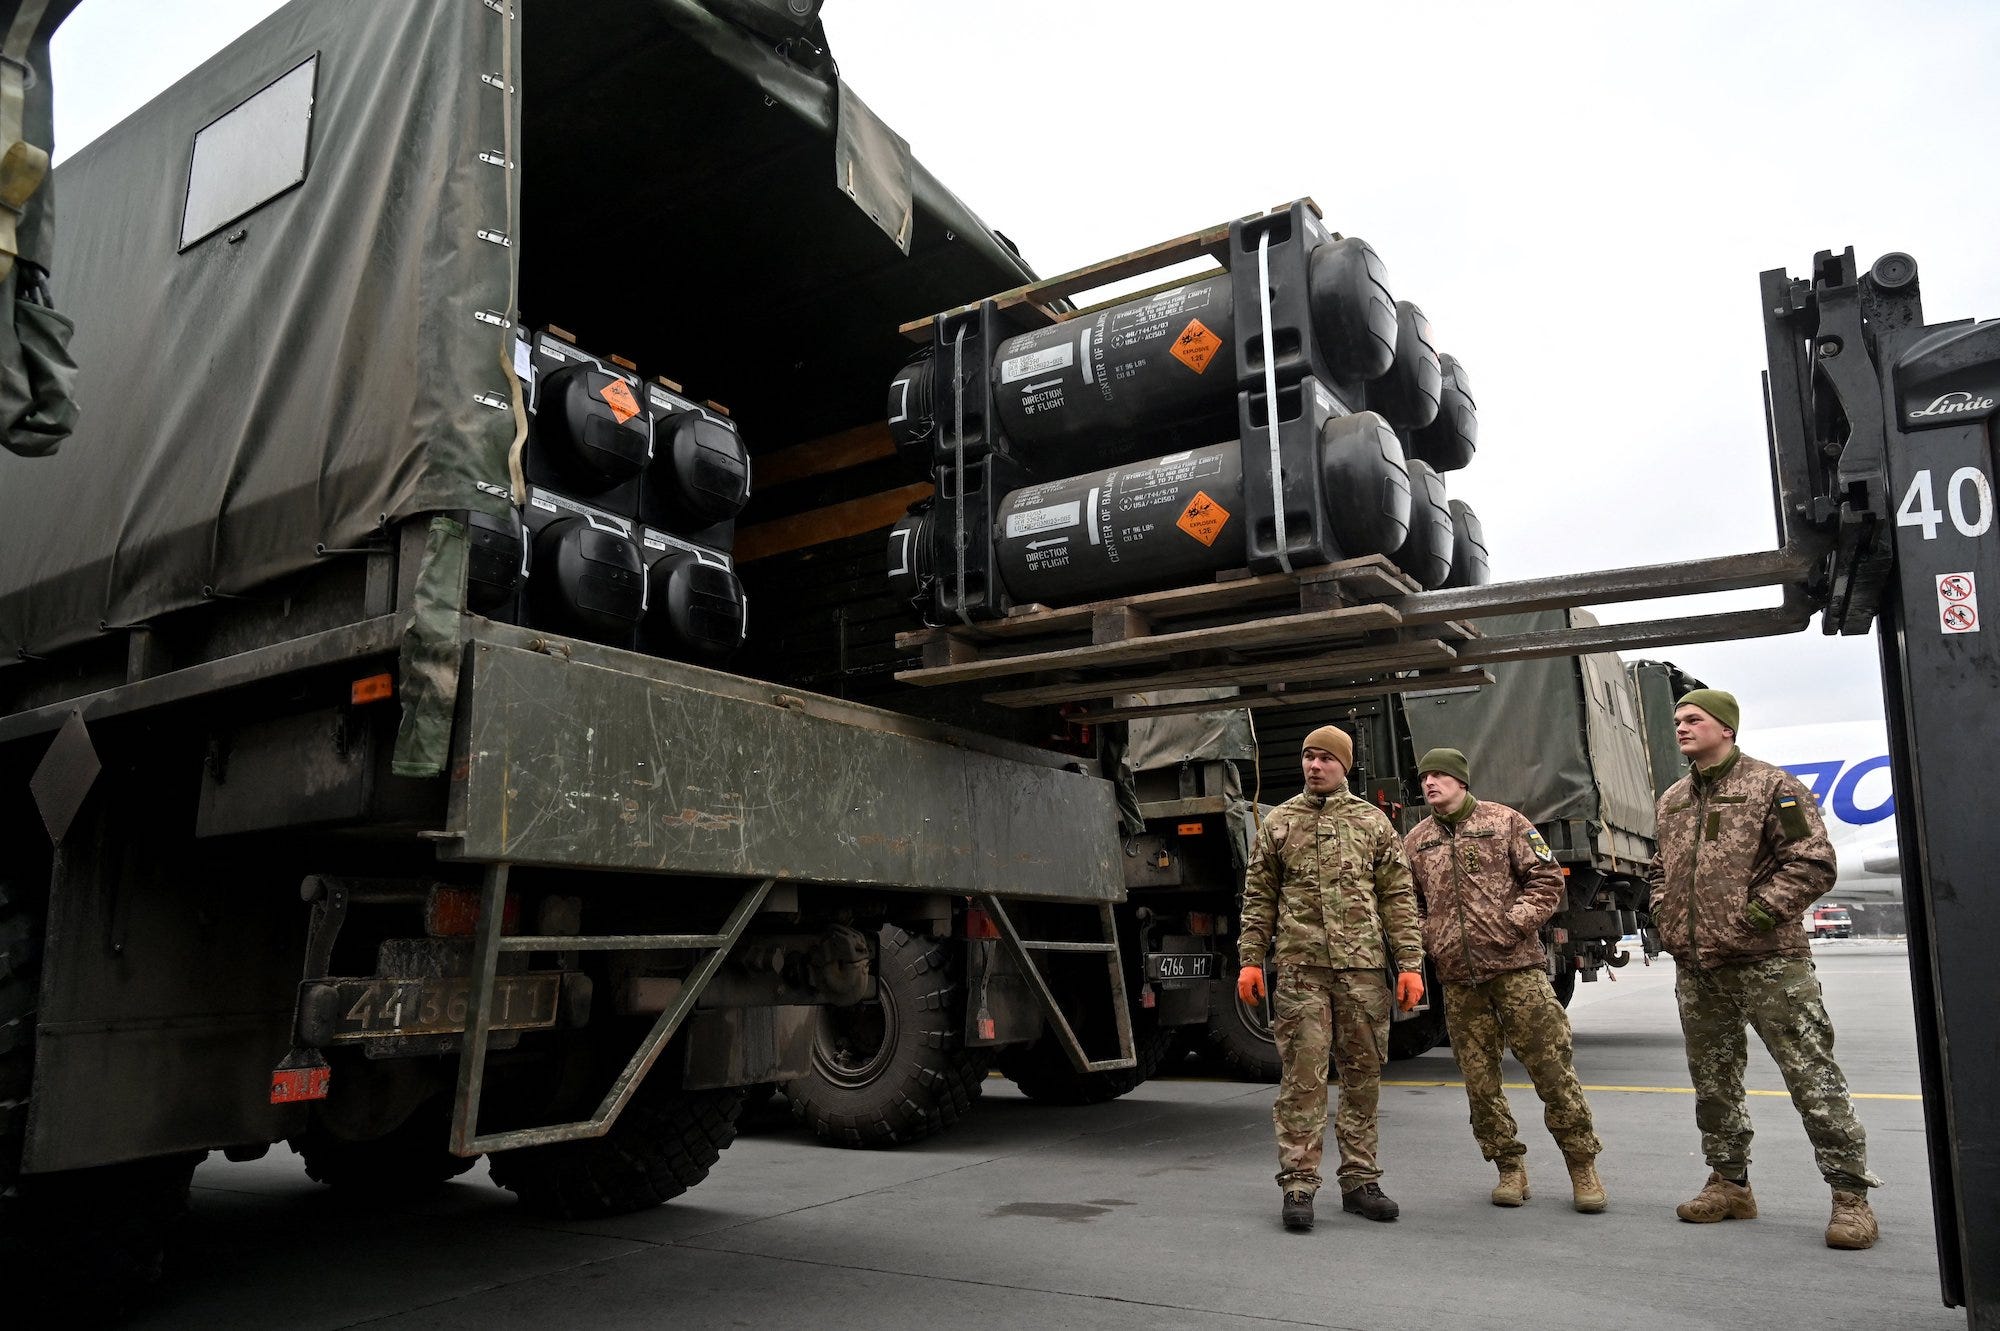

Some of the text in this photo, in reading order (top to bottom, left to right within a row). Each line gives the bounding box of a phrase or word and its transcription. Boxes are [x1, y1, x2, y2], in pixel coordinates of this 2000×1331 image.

[1094, 347, 1104, 360] OF
[1096, 362, 1114, 401] CENTER
[1022, 388, 1063, 406] DIRECTION
[1909, 391, 1994, 418] Linde
[1024, 398, 1066, 415] OF FLIGHT
[1896, 466, 1994, 540] 40
[1102, 509, 1111, 522] OF
[1190, 519, 1217, 528] EXPLOSIVE
[1142, 524, 1154, 532] LBS
[1103, 525, 1120, 563] CENTER
[1026, 546, 1068, 562] DIRECTION
[1028, 556, 1070, 572] OF FLIGHT
[1160, 957, 1206, 976] 4766 H1
